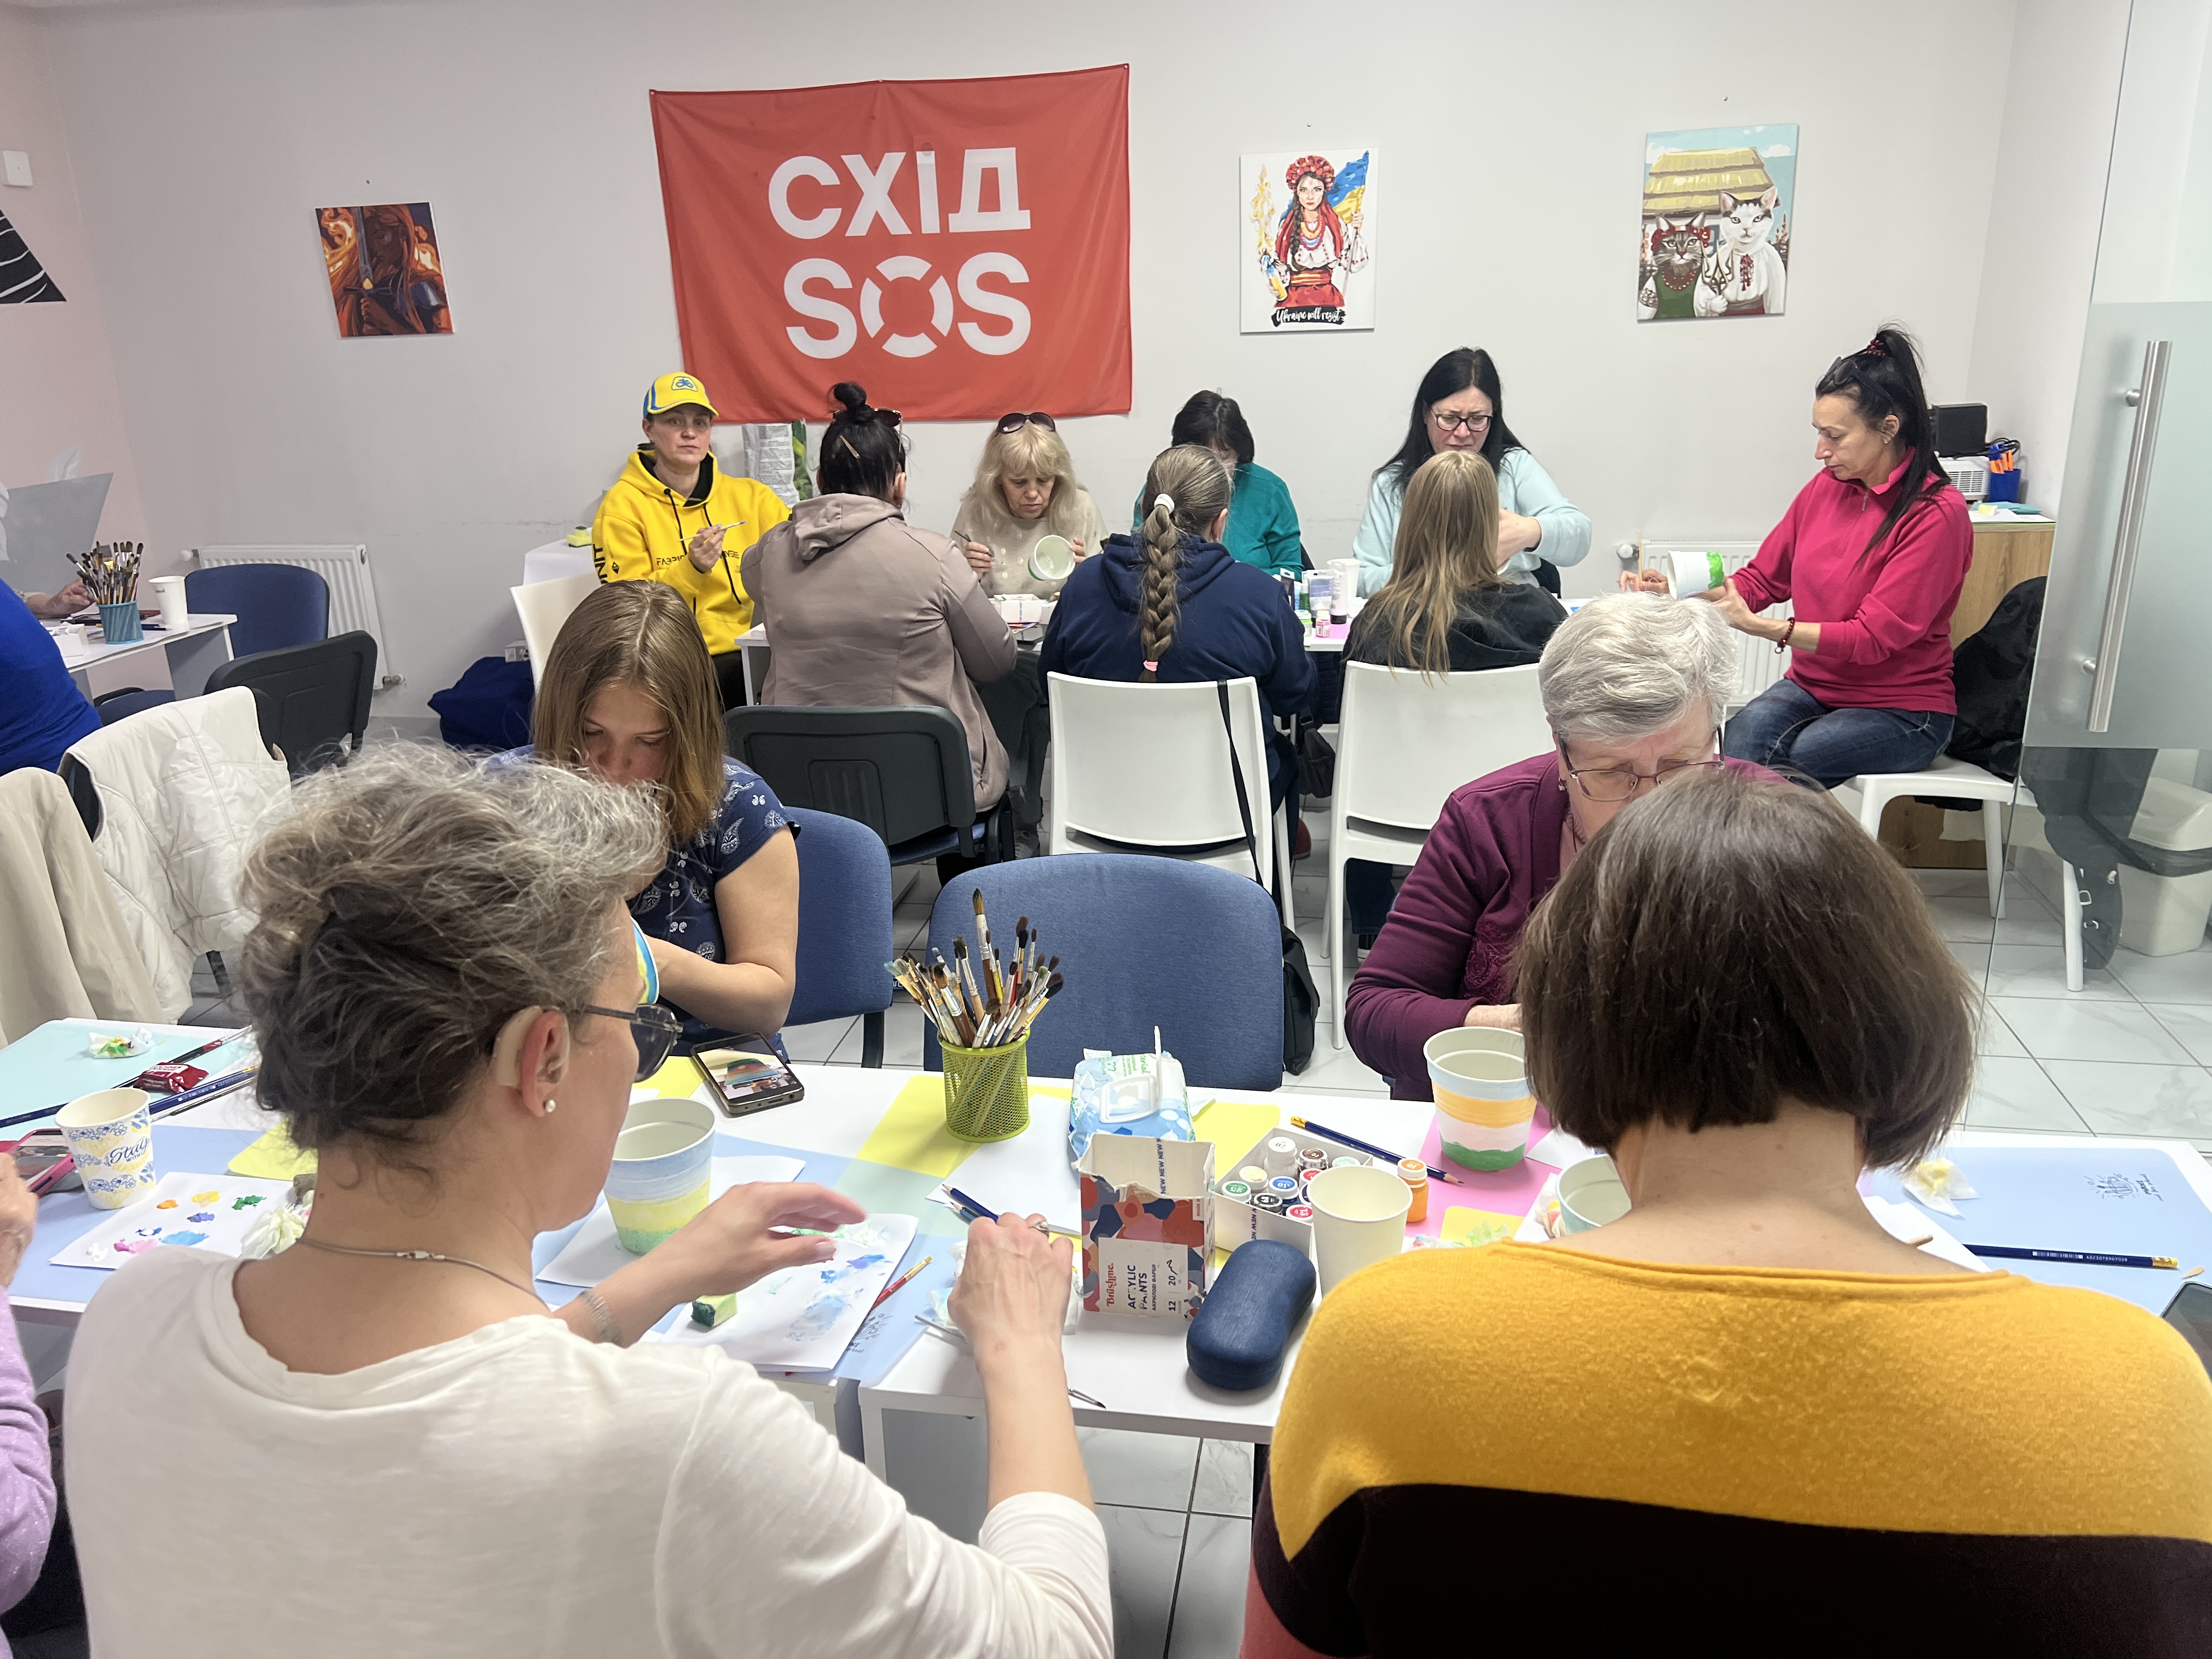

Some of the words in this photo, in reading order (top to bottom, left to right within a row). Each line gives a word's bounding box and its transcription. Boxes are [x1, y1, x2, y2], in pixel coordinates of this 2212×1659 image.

[768, 147, 1031, 240] СХІД
[783, 252, 1031, 359] SOS
[1140, 1054, 1151, 1074] terial
[109, 1136, 150, 1164] Stay
[1127, 1265, 1136, 1310] ACYLIC
[1169, 1276, 1176, 1286] 20
[1169, 1301, 1176, 1312] 12
